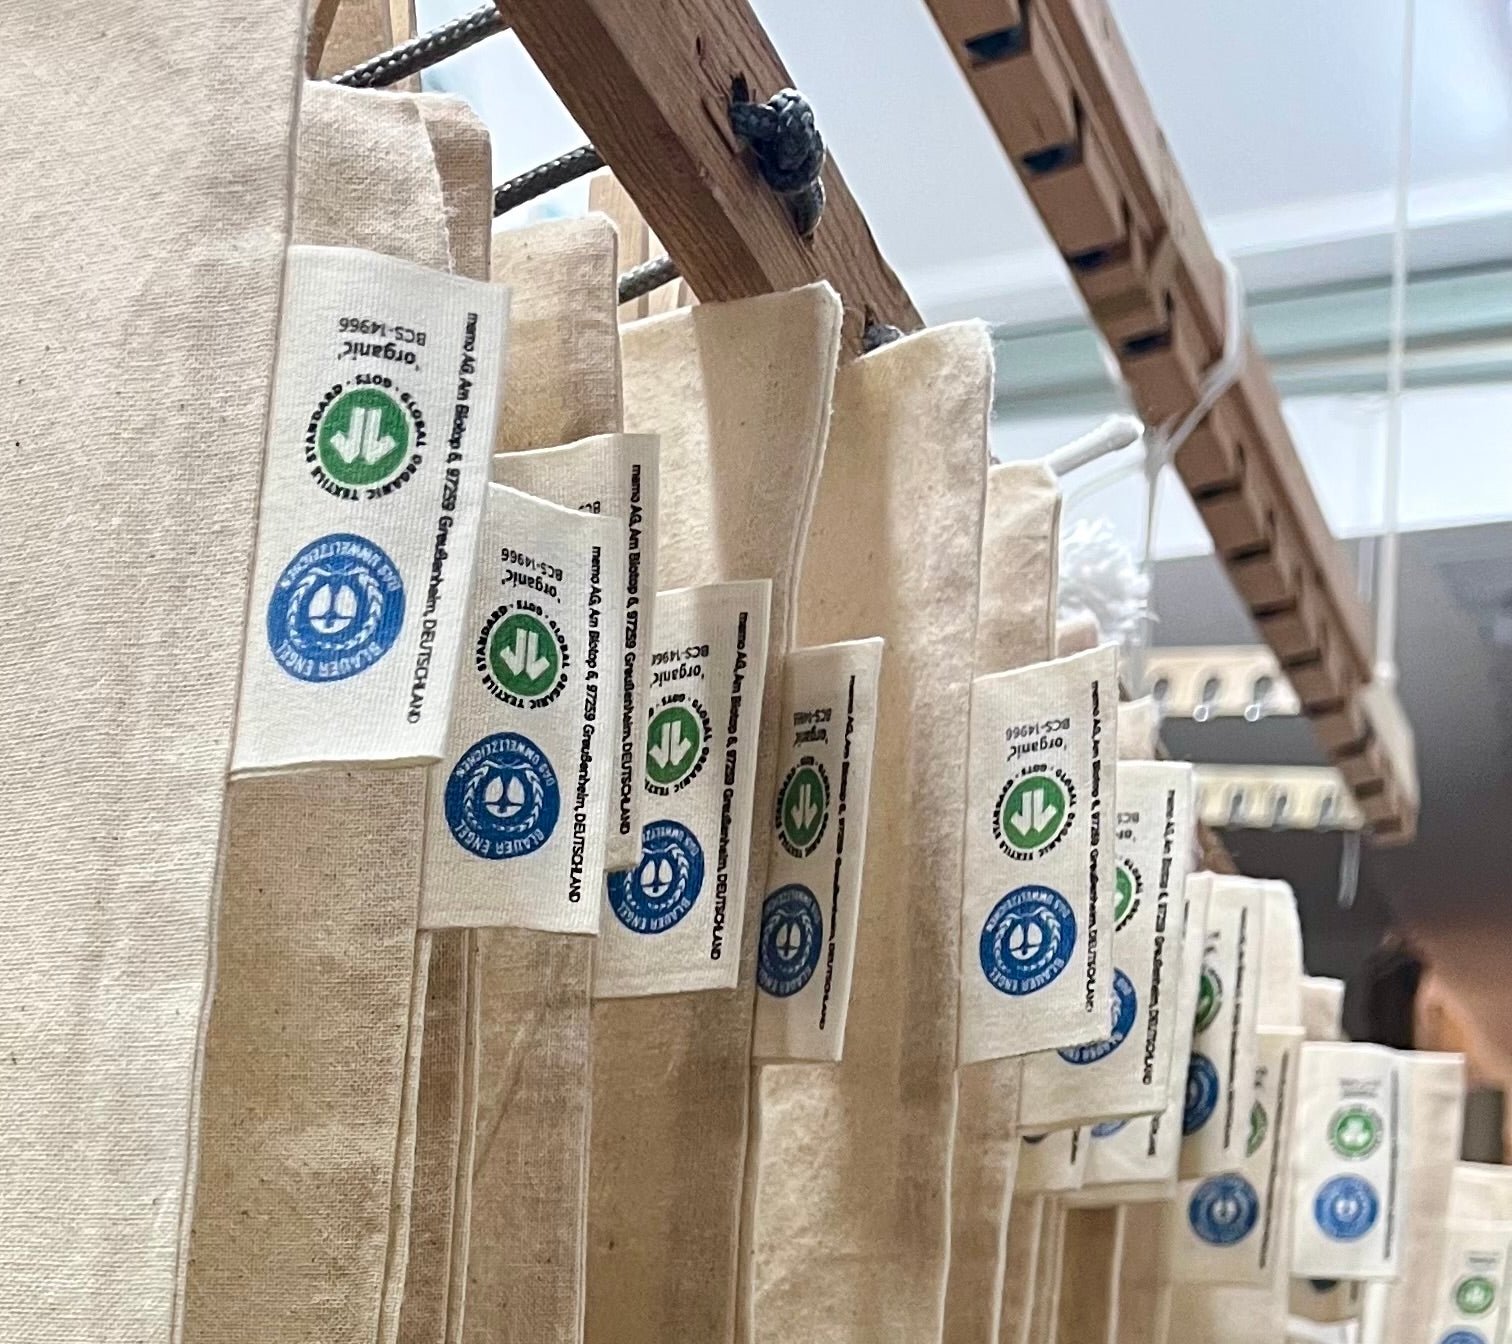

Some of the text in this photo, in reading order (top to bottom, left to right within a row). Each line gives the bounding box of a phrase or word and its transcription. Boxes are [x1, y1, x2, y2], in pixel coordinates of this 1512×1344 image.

[339, 318, 426, 346] BCS-14966
[457, 378, 473, 400] Am
[442, 468, 460, 511] 97259
[630, 464, 641, 502] memo
[629, 528, 641, 550] Am
[501, 548, 563, 581] BCS-14966
[590, 545, 601, 584] memo
[627, 551, 640, 595] Biotop
[589, 608, 600, 628] Am
[625, 610, 638, 649] 97259
[275, 640, 385, 678] BLAUER ENGEL
[585, 630, 600, 668] Biotop
[407, 619, 437, 724] DEUTSCHLAND
[732, 674, 744, 693] Am
[584, 683, 599, 721] 97259
[619, 742, 633, 835] DEUTSCHLAND
[455, 819, 544, 855] BLAUER ENGEL
[569, 813, 586, 904] DEUTSCHLAND
[650, 897, 691, 931] BLAUER
[710, 873, 728, 960] DEUTSCHLAND
